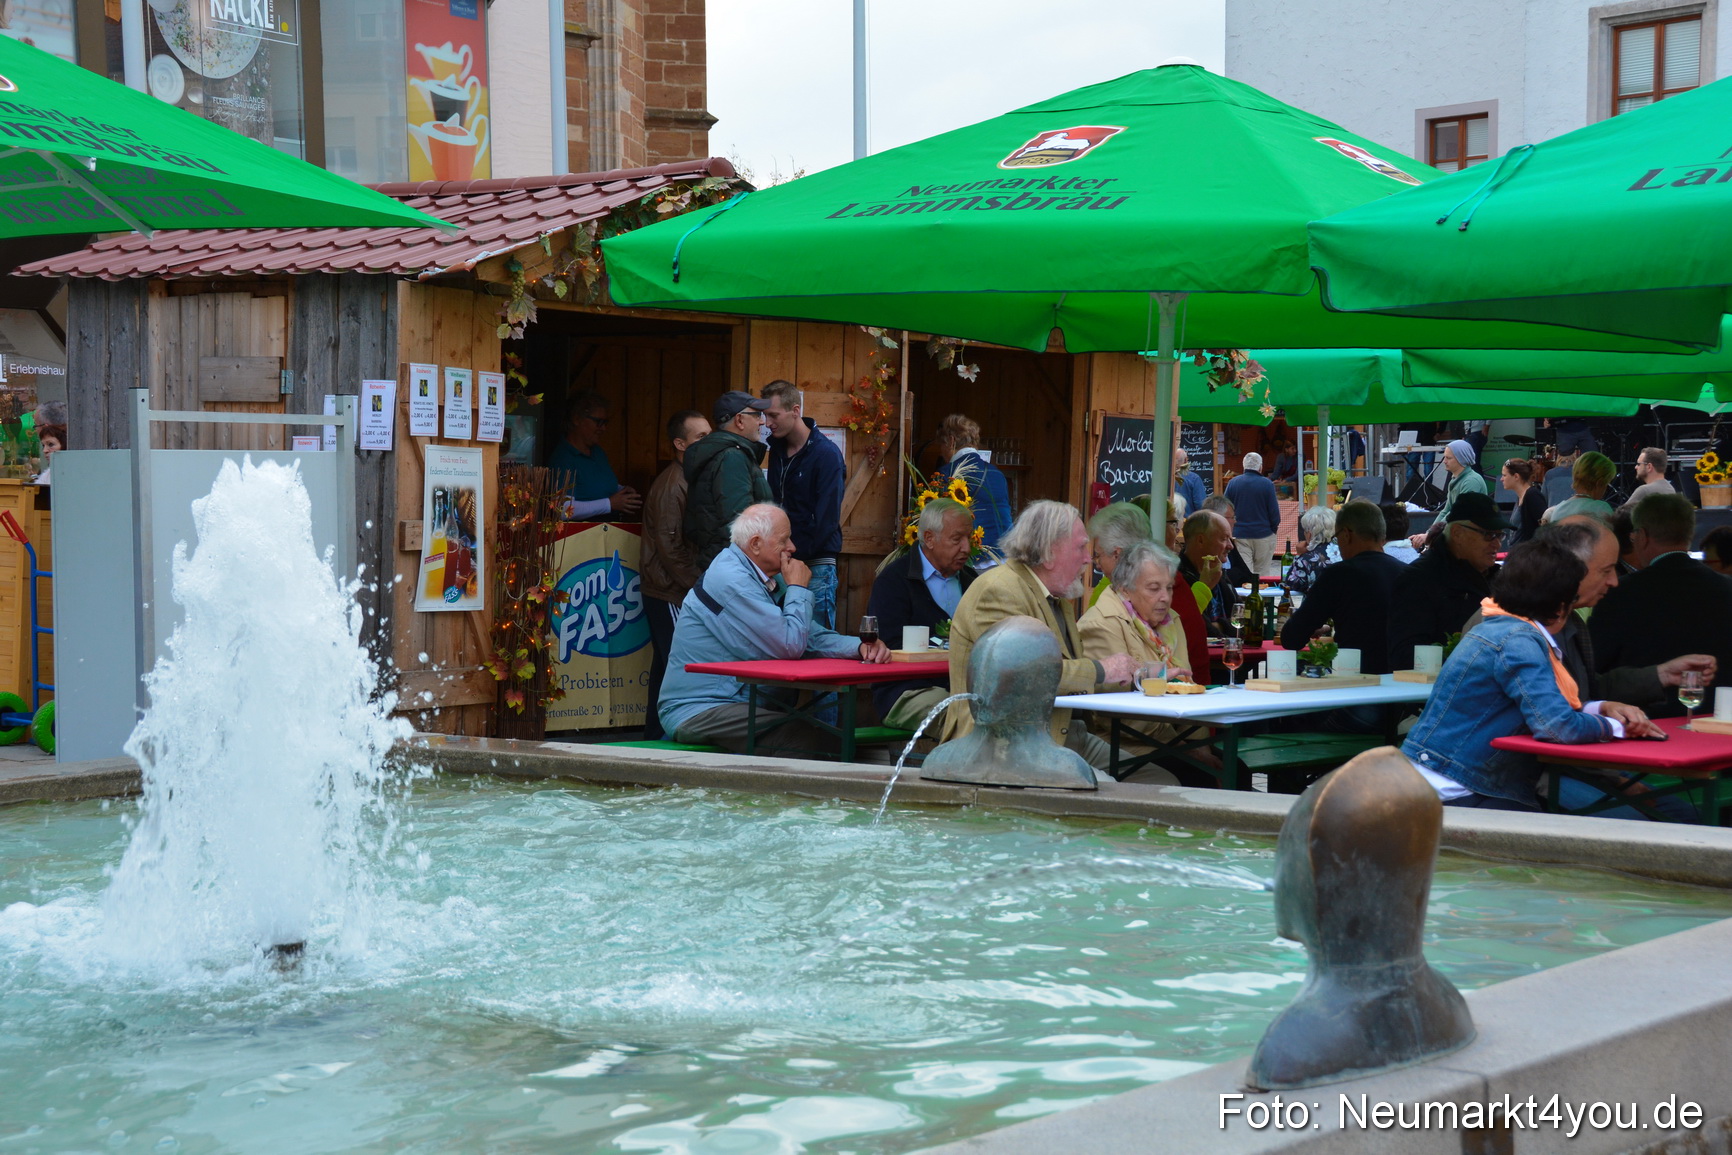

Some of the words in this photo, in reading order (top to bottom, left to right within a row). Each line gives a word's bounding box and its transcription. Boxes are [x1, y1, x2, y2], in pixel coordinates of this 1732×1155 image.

[233, 93, 265, 105] BRILLANCE
[235, 100, 266, 112] SAUVAGES
[895, 176, 1119, 198] Neumarkter
[825, 191, 1131, 219] Lammsbräu
[558, 574, 644, 662] FASS
[592, 705, 604, 716] 20
